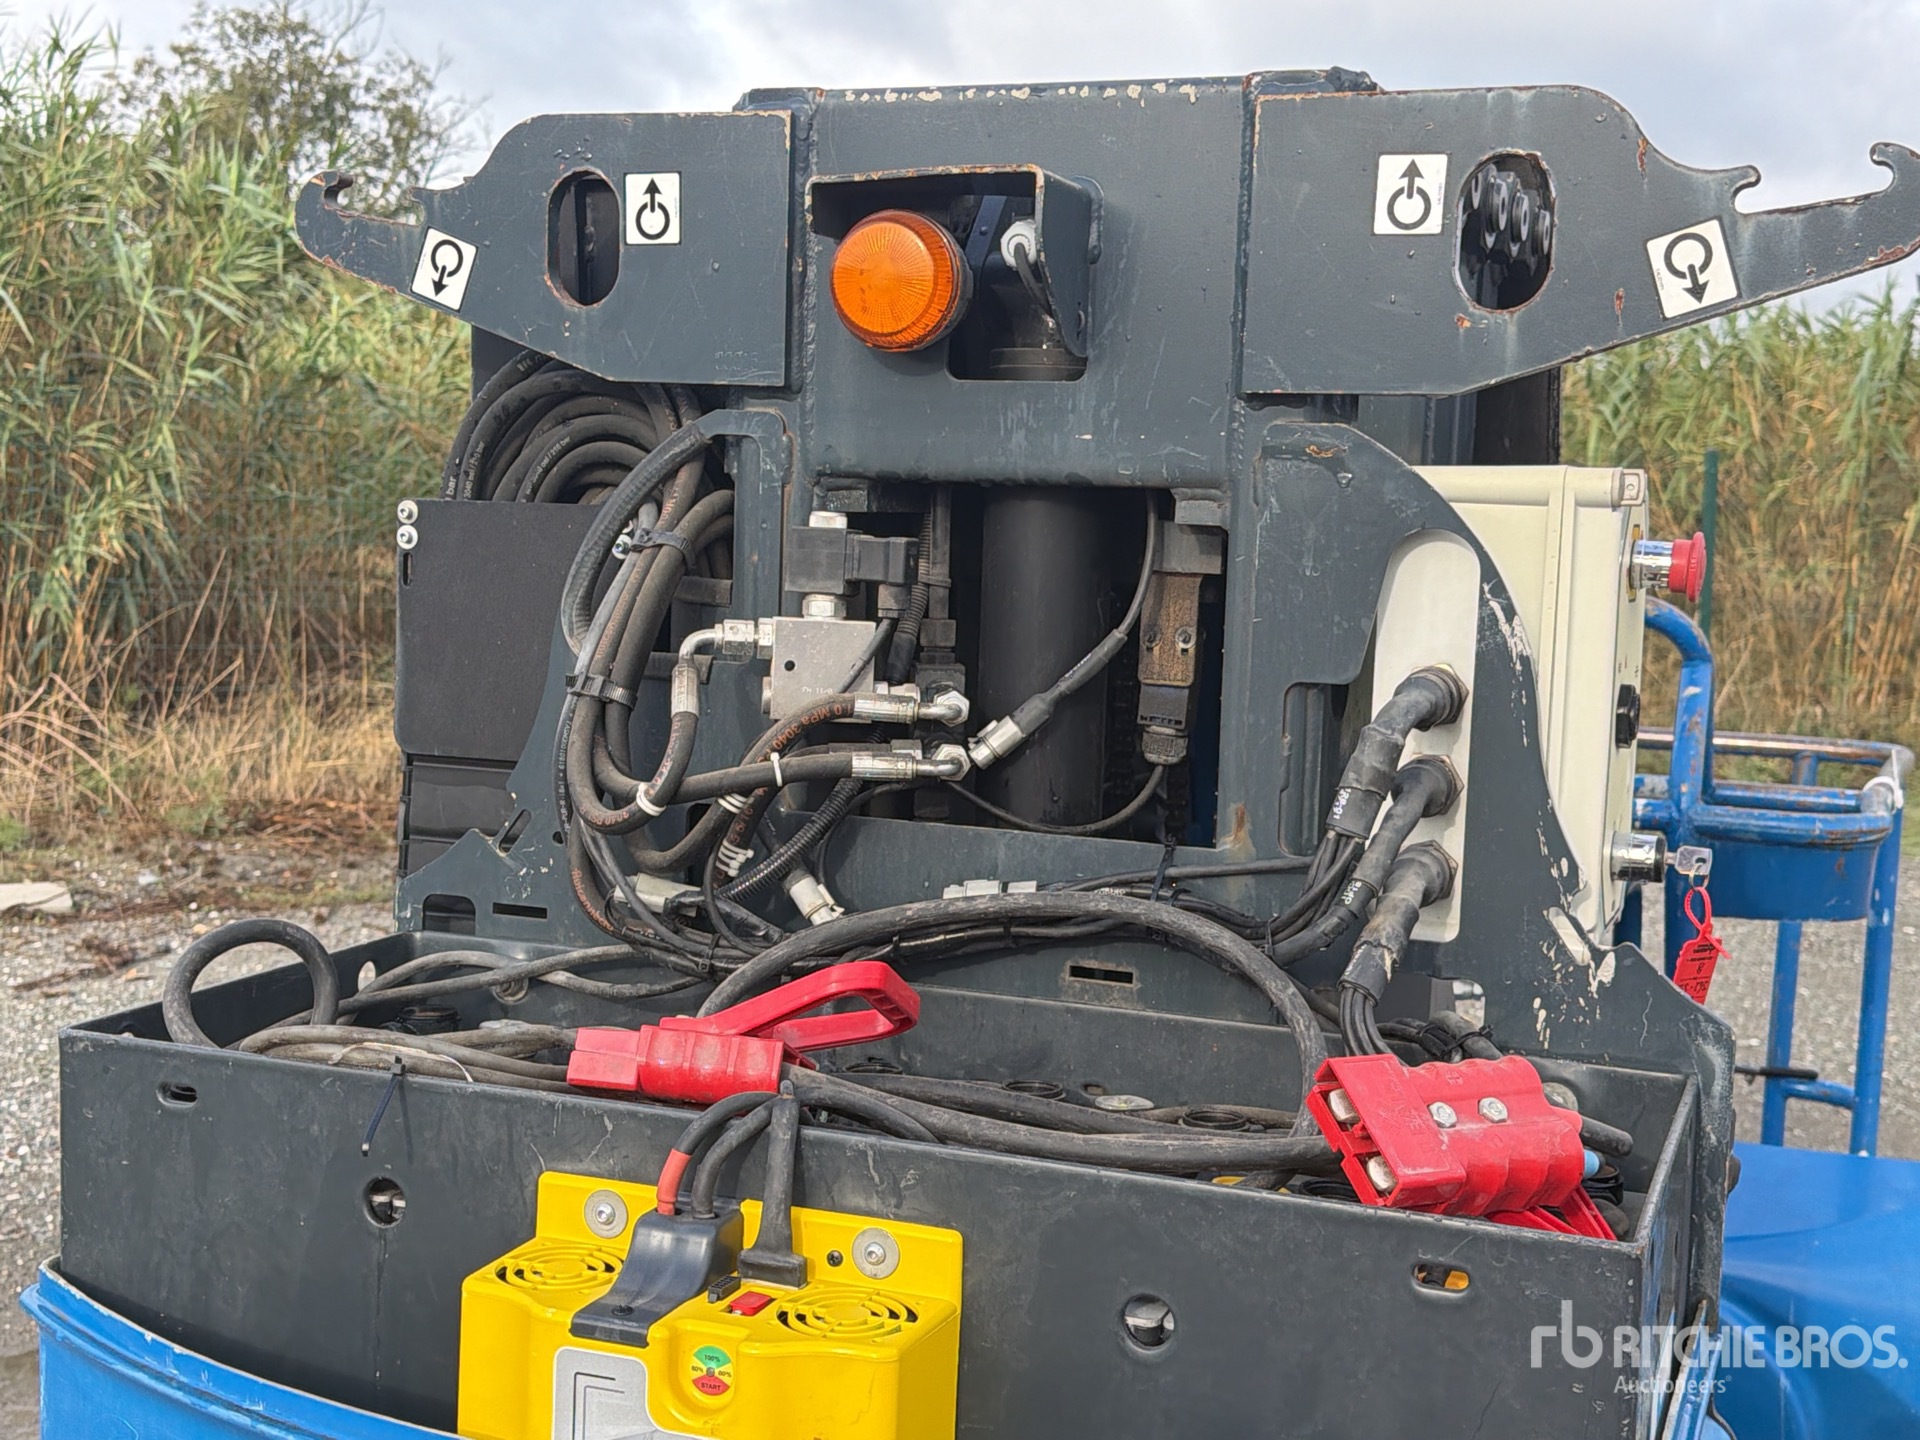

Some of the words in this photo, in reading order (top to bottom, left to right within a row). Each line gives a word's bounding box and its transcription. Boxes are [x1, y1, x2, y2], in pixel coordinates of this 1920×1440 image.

[801, 707, 830, 724] MPa
[772, 724, 800, 749] 3040
[704, 1354, 721, 1363] 100%
[700, 1382, 721, 1391] START
